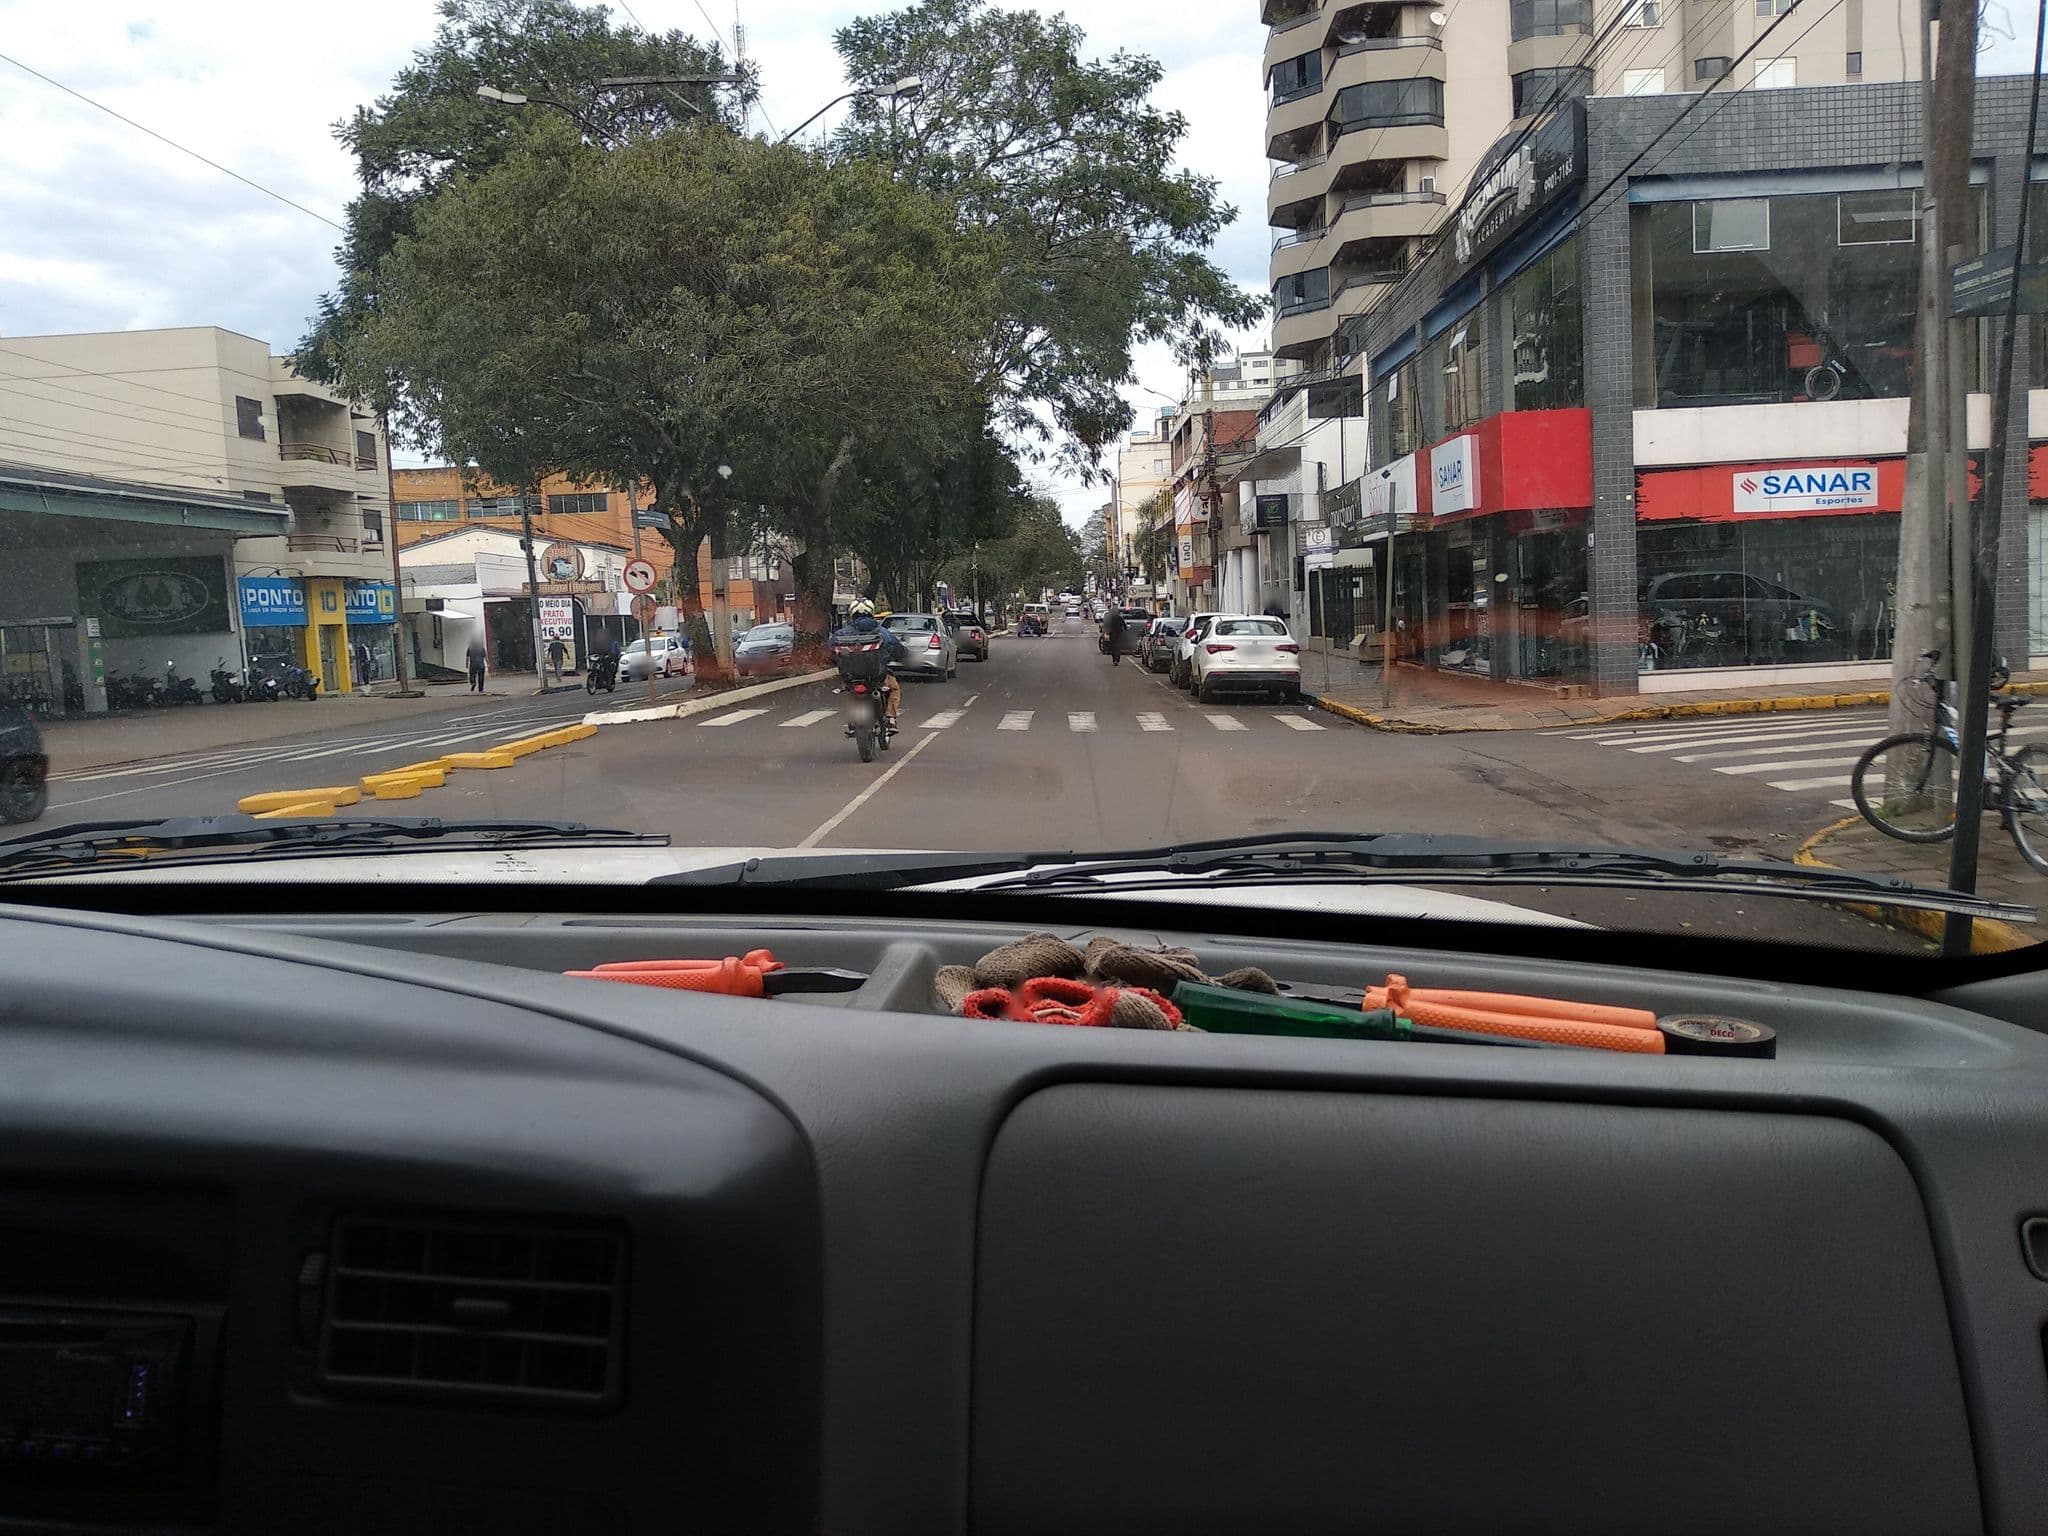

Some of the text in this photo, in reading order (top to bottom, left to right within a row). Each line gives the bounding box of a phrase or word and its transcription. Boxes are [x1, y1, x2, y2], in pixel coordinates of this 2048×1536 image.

[1477, 203, 1513, 244] ACADEMIA
[1439, 460, 1462, 489] SANAR
[1763, 472, 1871, 495] SANAR
[1815, 496, 1863, 506] Esportes
[246, 588, 304, 607] PONTO
[321, 590, 338, 612] 10
[376, 589, 394, 614] 10
[544, 600, 560, 608] MEIO
[561, 600, 571, 608] DIA
[539, 618, 573, 626] XECUTIVO
[543, 610, 565, 618] PRATO
